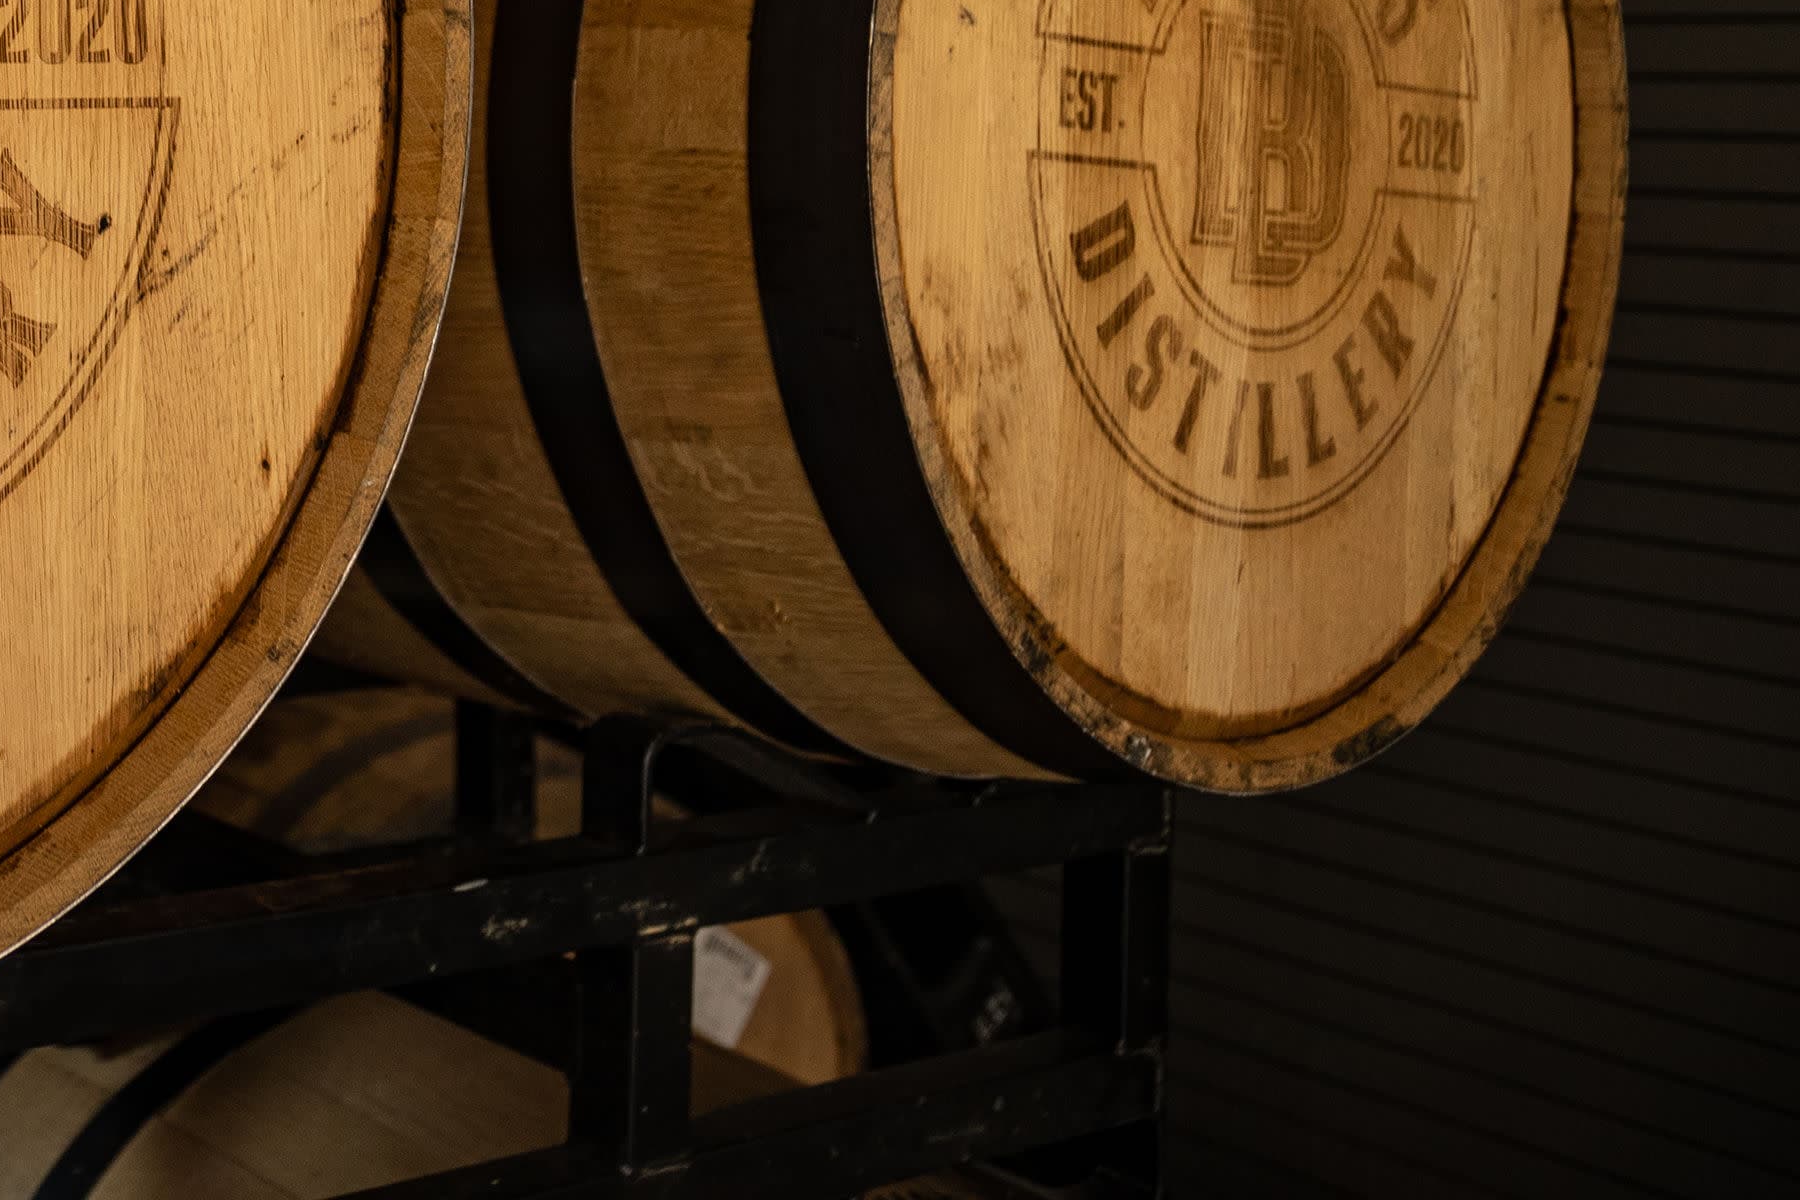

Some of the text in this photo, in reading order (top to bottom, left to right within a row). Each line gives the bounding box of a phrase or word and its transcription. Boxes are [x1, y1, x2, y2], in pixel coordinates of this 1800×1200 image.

[1059, 68, 1125, 133] EST.
[1397, 112, 1465, 174] 2020
[1069, 199, 1438, 481] DISTILLERY
